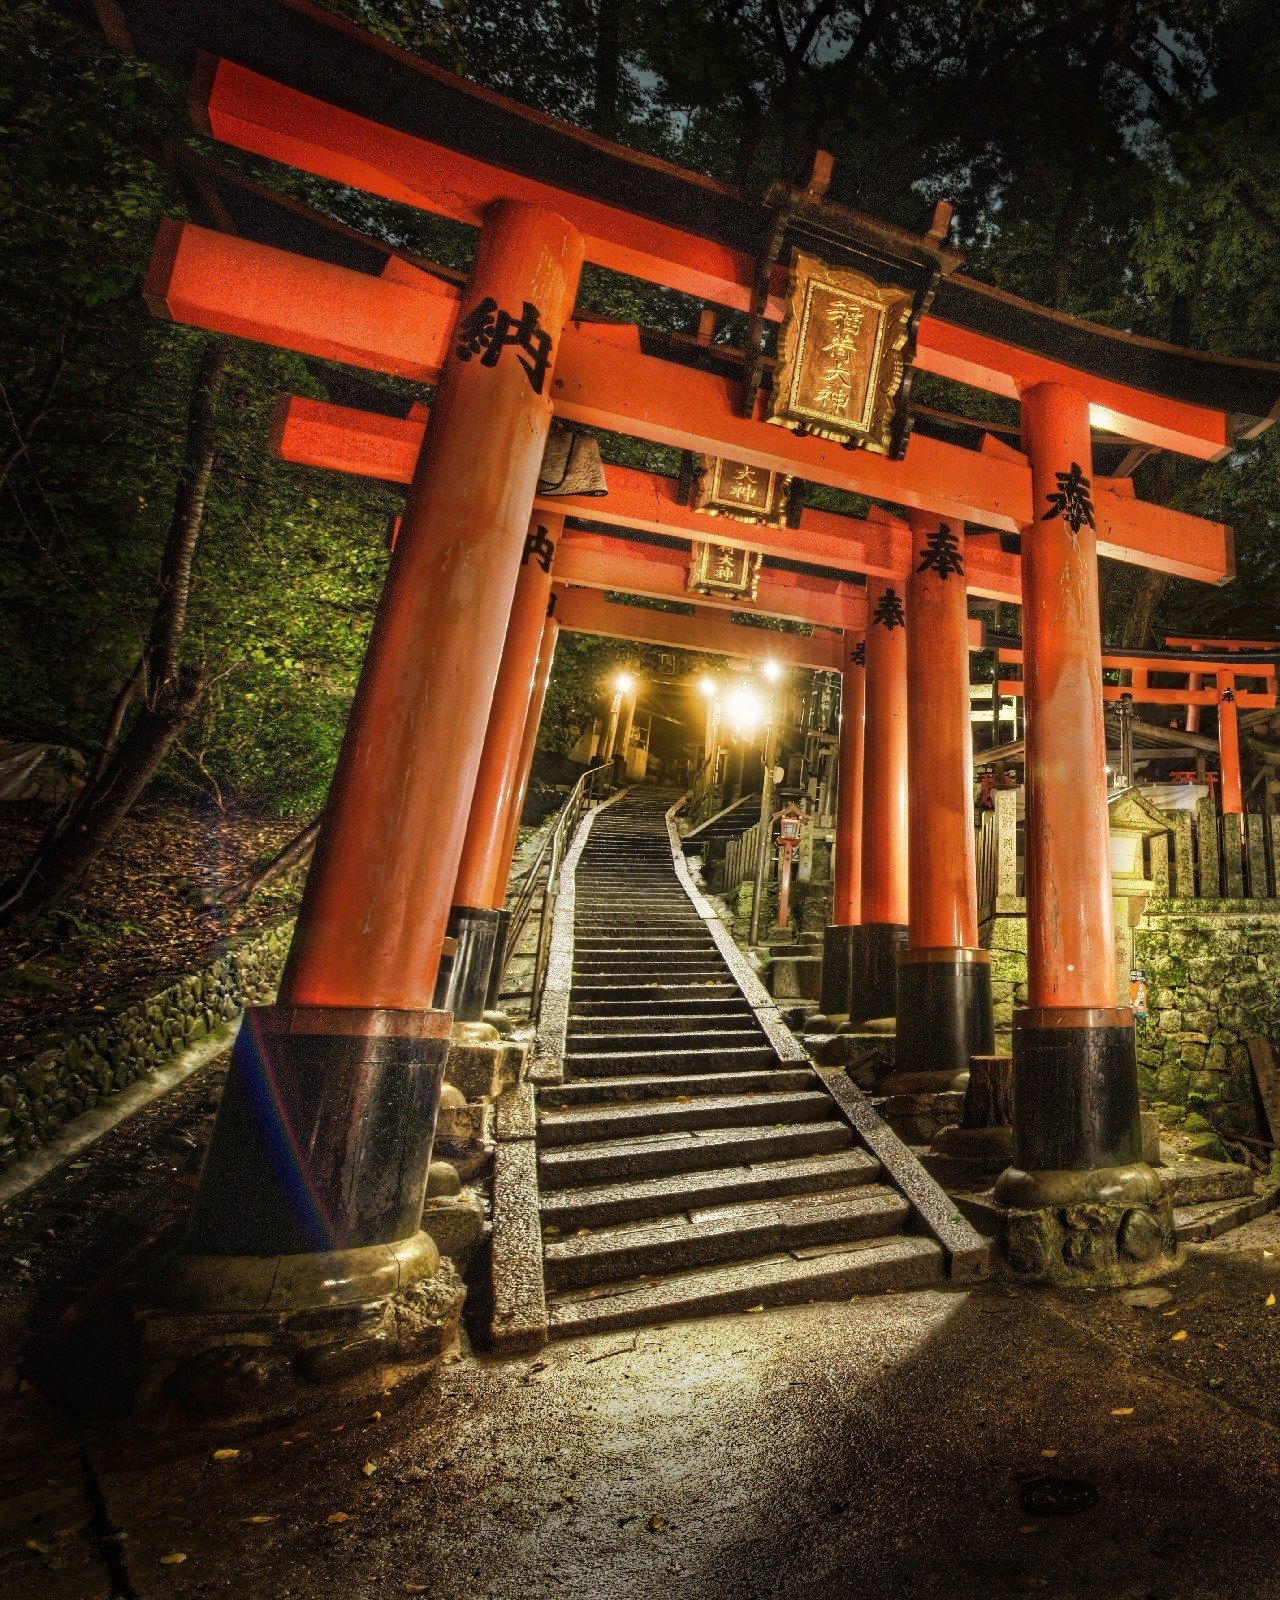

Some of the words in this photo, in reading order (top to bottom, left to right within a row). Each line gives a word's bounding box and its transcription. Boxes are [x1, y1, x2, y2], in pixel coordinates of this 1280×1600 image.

[456, 296, 553, 395] 納
[1041, 461, 1096, 533] 奉
[916, 522, 965, 581] 奉
[872, 588, 906, 631] 奉
